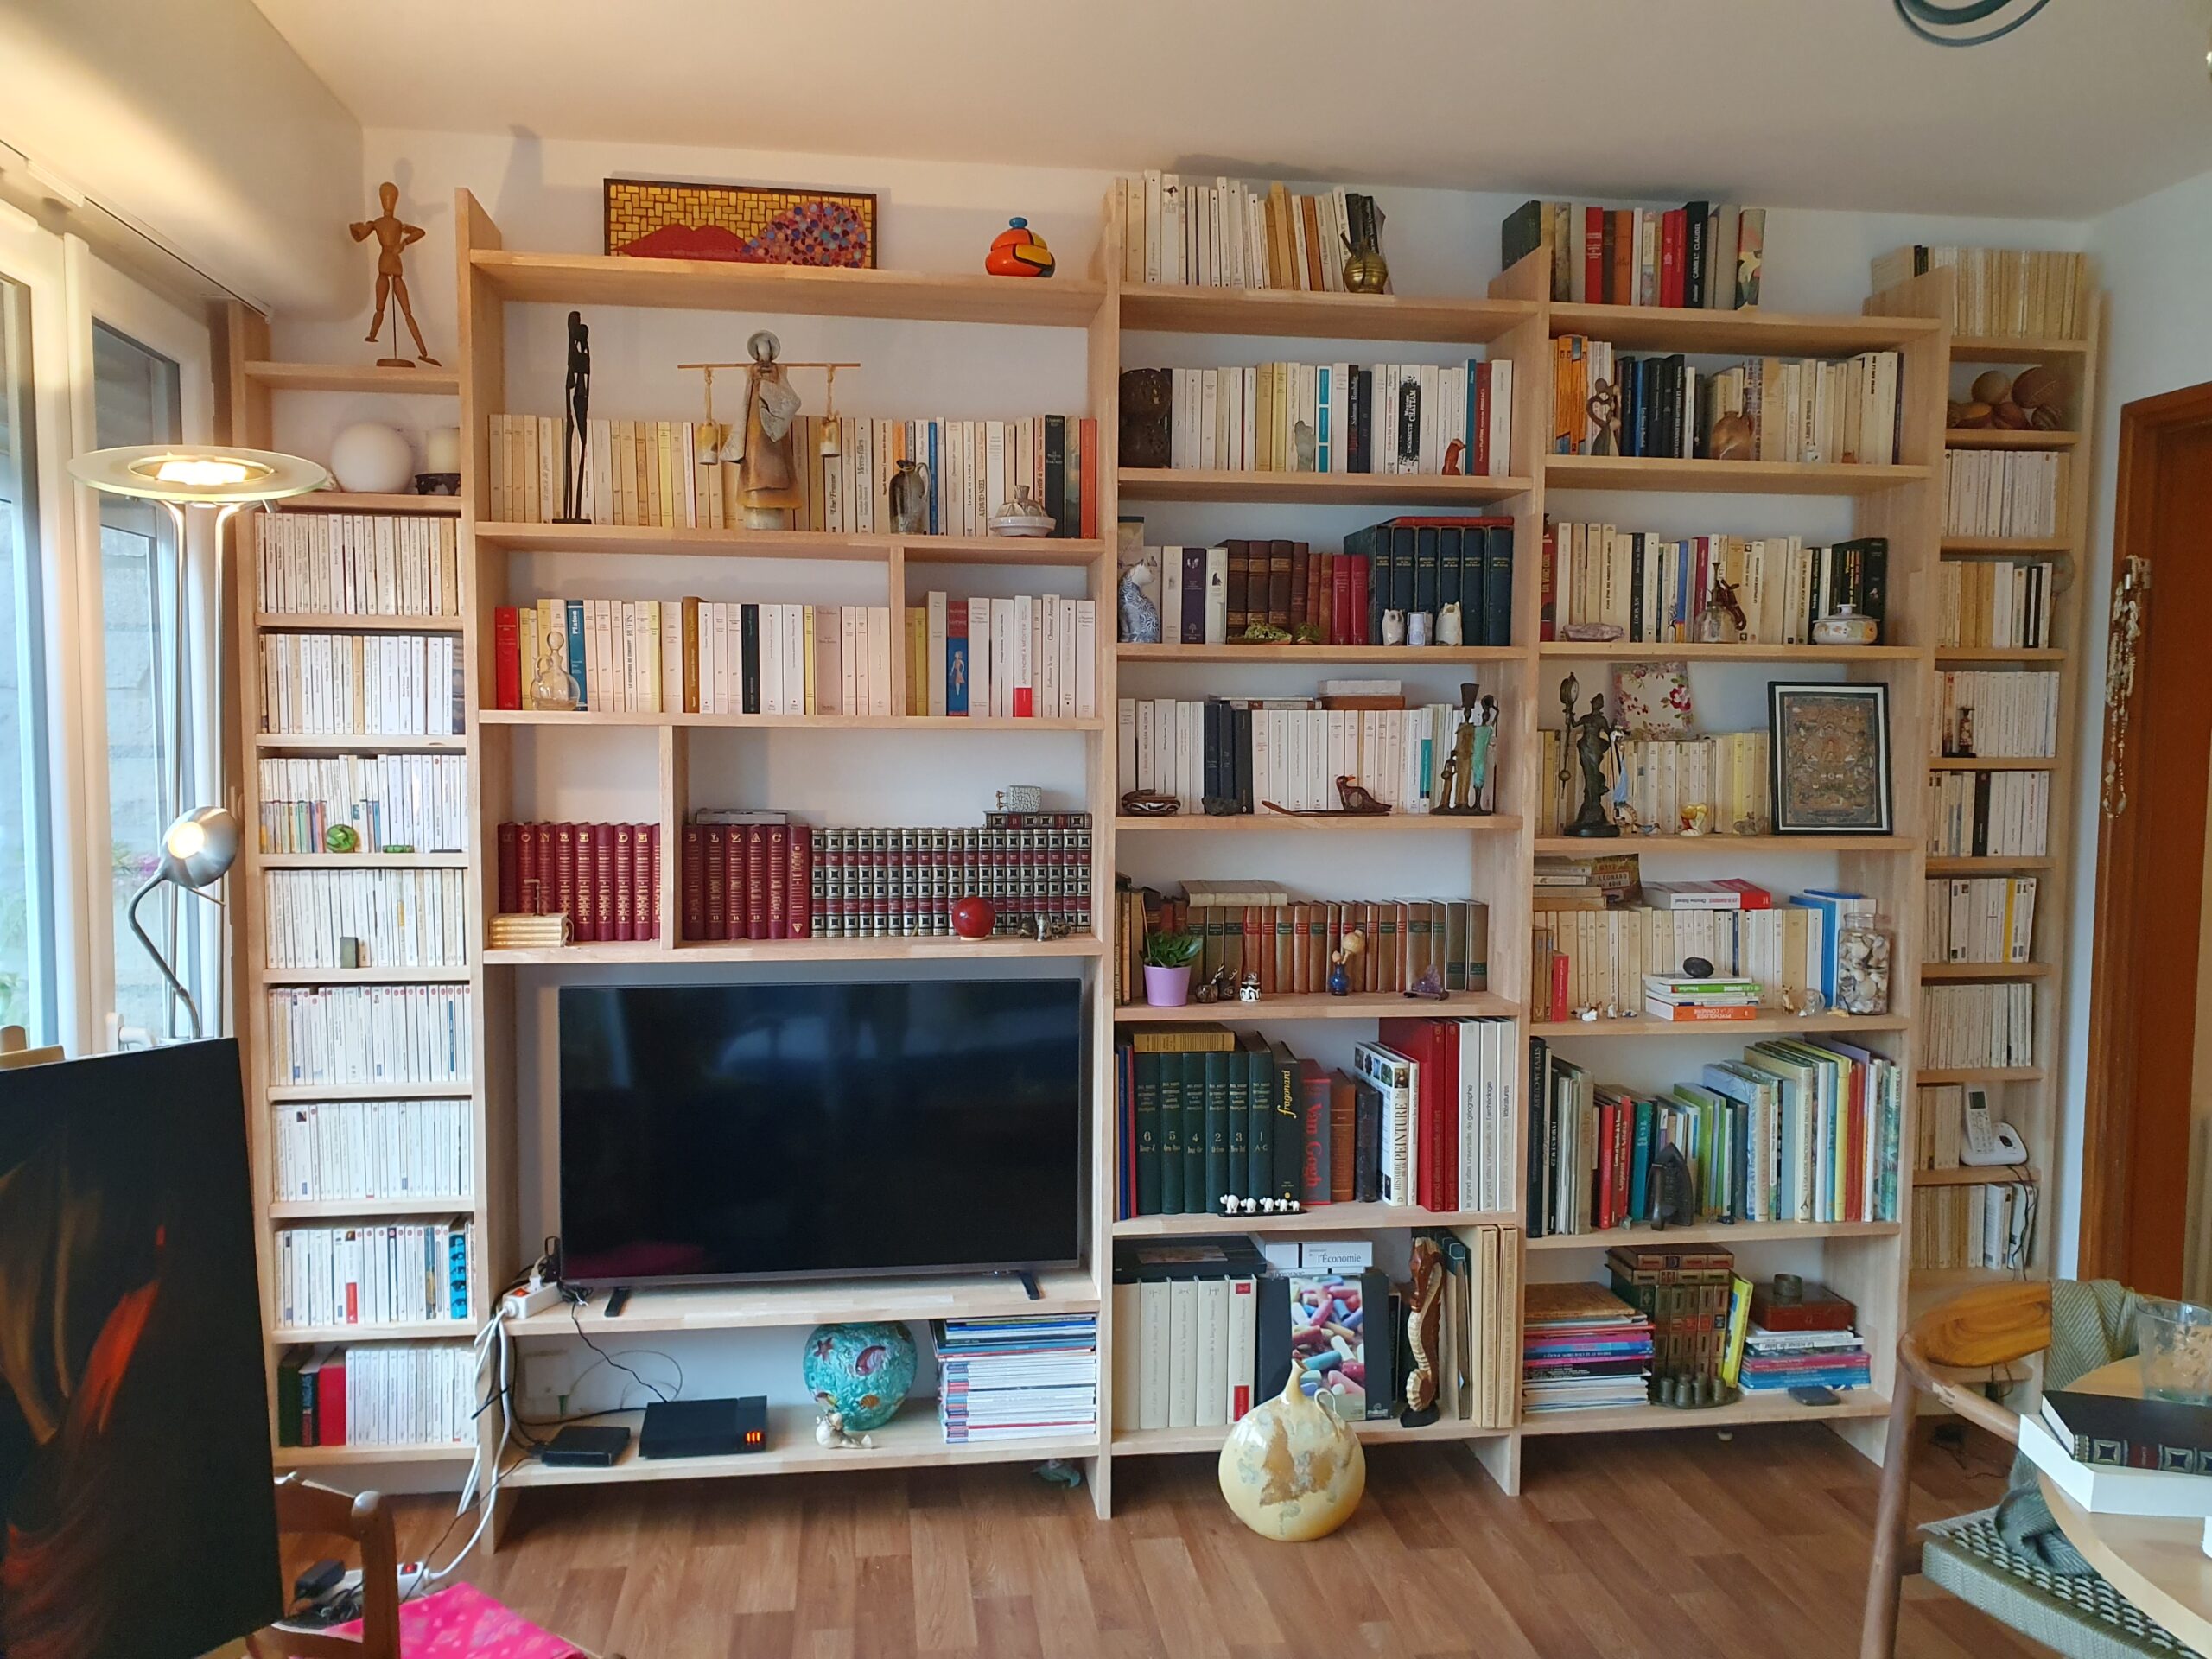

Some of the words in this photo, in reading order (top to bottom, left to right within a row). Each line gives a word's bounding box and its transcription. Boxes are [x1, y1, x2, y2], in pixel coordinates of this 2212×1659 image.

[1277, 1070, 1297, 1119] fragonard
[1465, 1085, 1474, 1121] géographie
[1306, 1103, 1322, 1135] Van
[1465, 1122, 1472, 1130] de
[1143, 1131, 1151, 1141] 6
[1169, 1131, 1176, 1141] 5
[1394, 1103, 1407, 1160] PEINTURE
[1192, 1134, 1198, 1142] 4
[1215, 1133, 1222, 1142] 2
[1236, 1132, 1243, 1142] 3
[1304, 1141, 1322, 1187] Gogh
[1317, 1254, 1362, 1263] l'Économie
